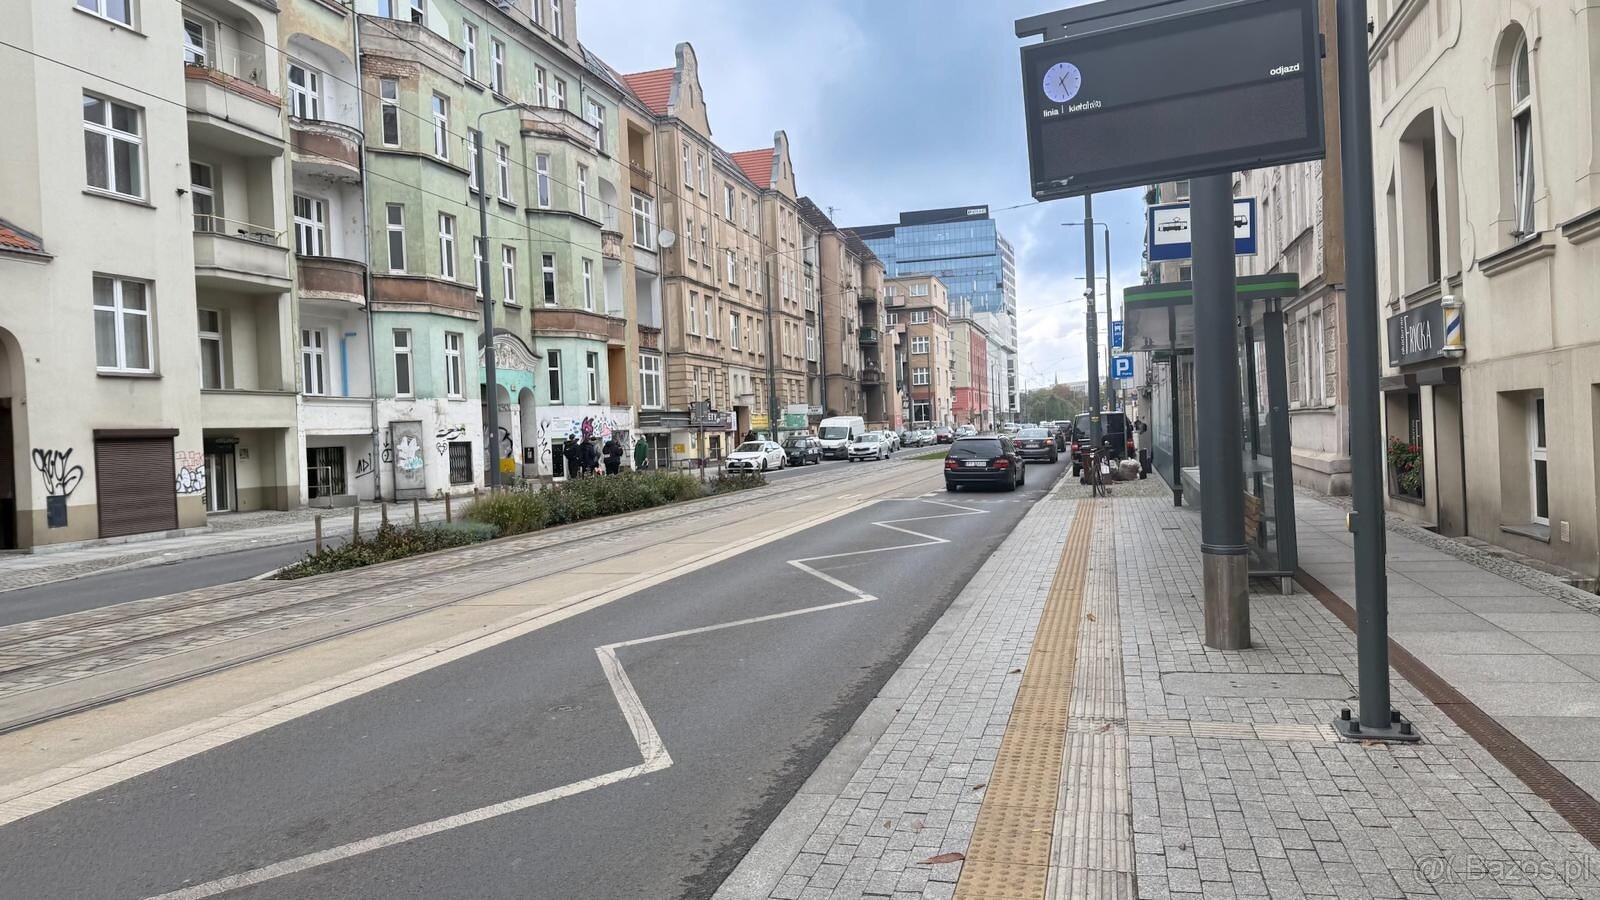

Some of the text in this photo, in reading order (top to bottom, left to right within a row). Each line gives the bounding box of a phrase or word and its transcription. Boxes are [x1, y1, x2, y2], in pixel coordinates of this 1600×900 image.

[1269, 62, 1300, 76] odjazd
[1043, 108, 1060, 118] linia
[1116, 358, 1129, 376] P
